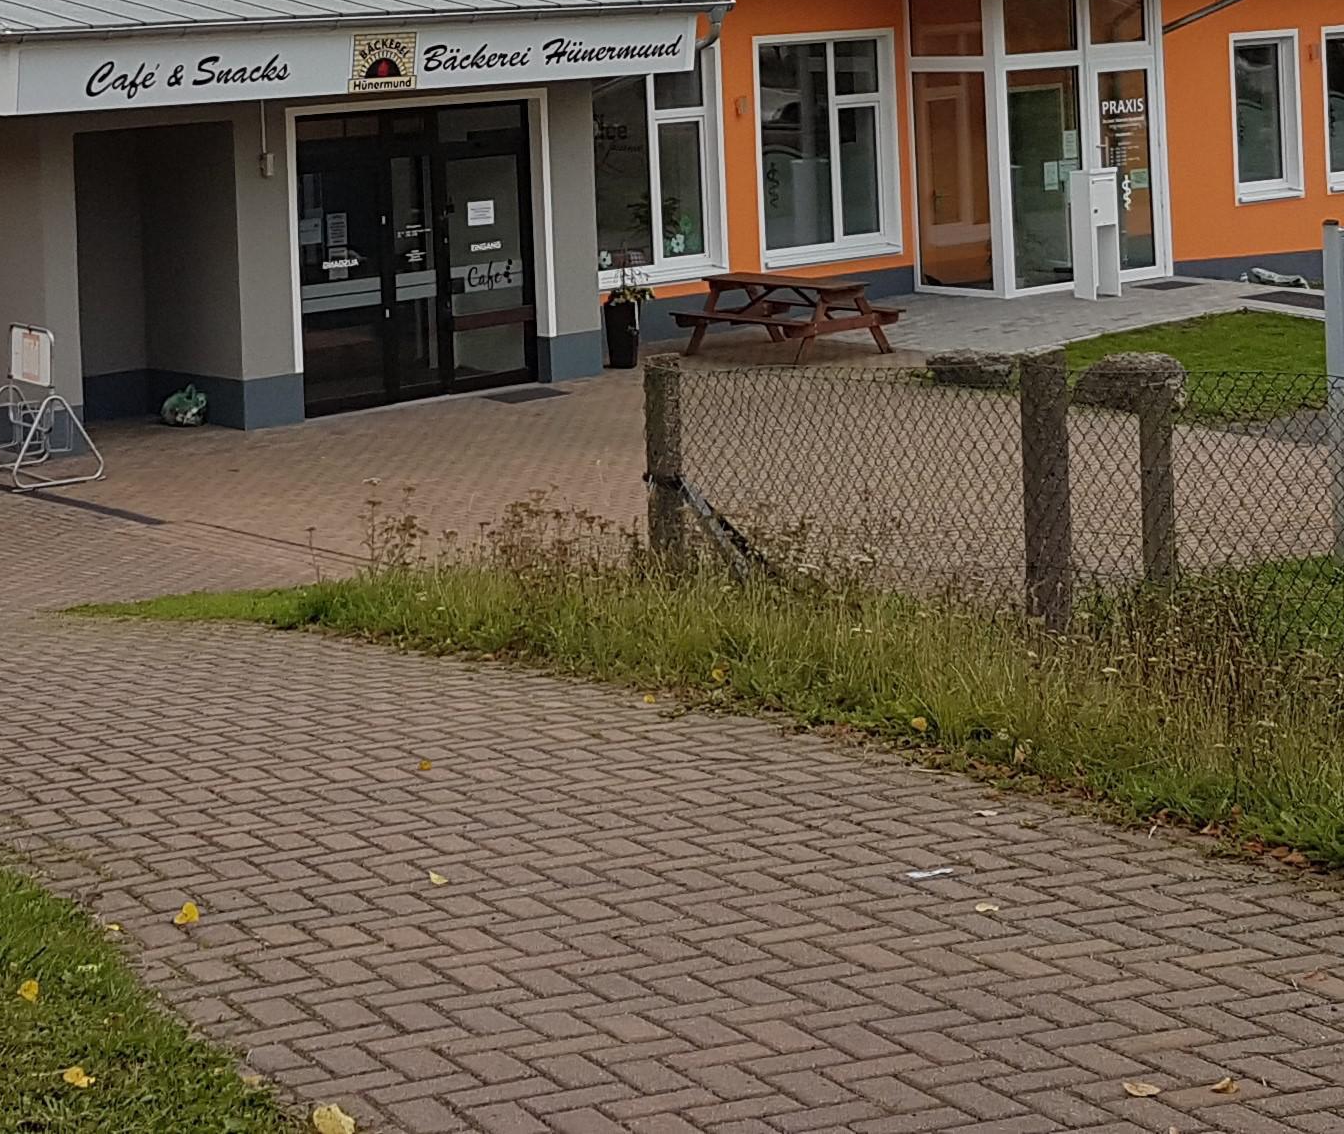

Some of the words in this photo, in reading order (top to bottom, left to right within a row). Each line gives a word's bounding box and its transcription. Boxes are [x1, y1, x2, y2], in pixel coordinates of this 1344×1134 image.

[359, 38, 410, 60] BÄCKEREI
[423, 44, 532, 72] Bäckerei
[542, 34, 683, 66] Hünermund
[86, 61, 160, 99] Café
[167, 65, 184, 87] &
[192, 54, 291, 86] Snacks
[353, 77, 412, 91] Hünermund
[1101, 97, 1144, 115] PRAXIS
